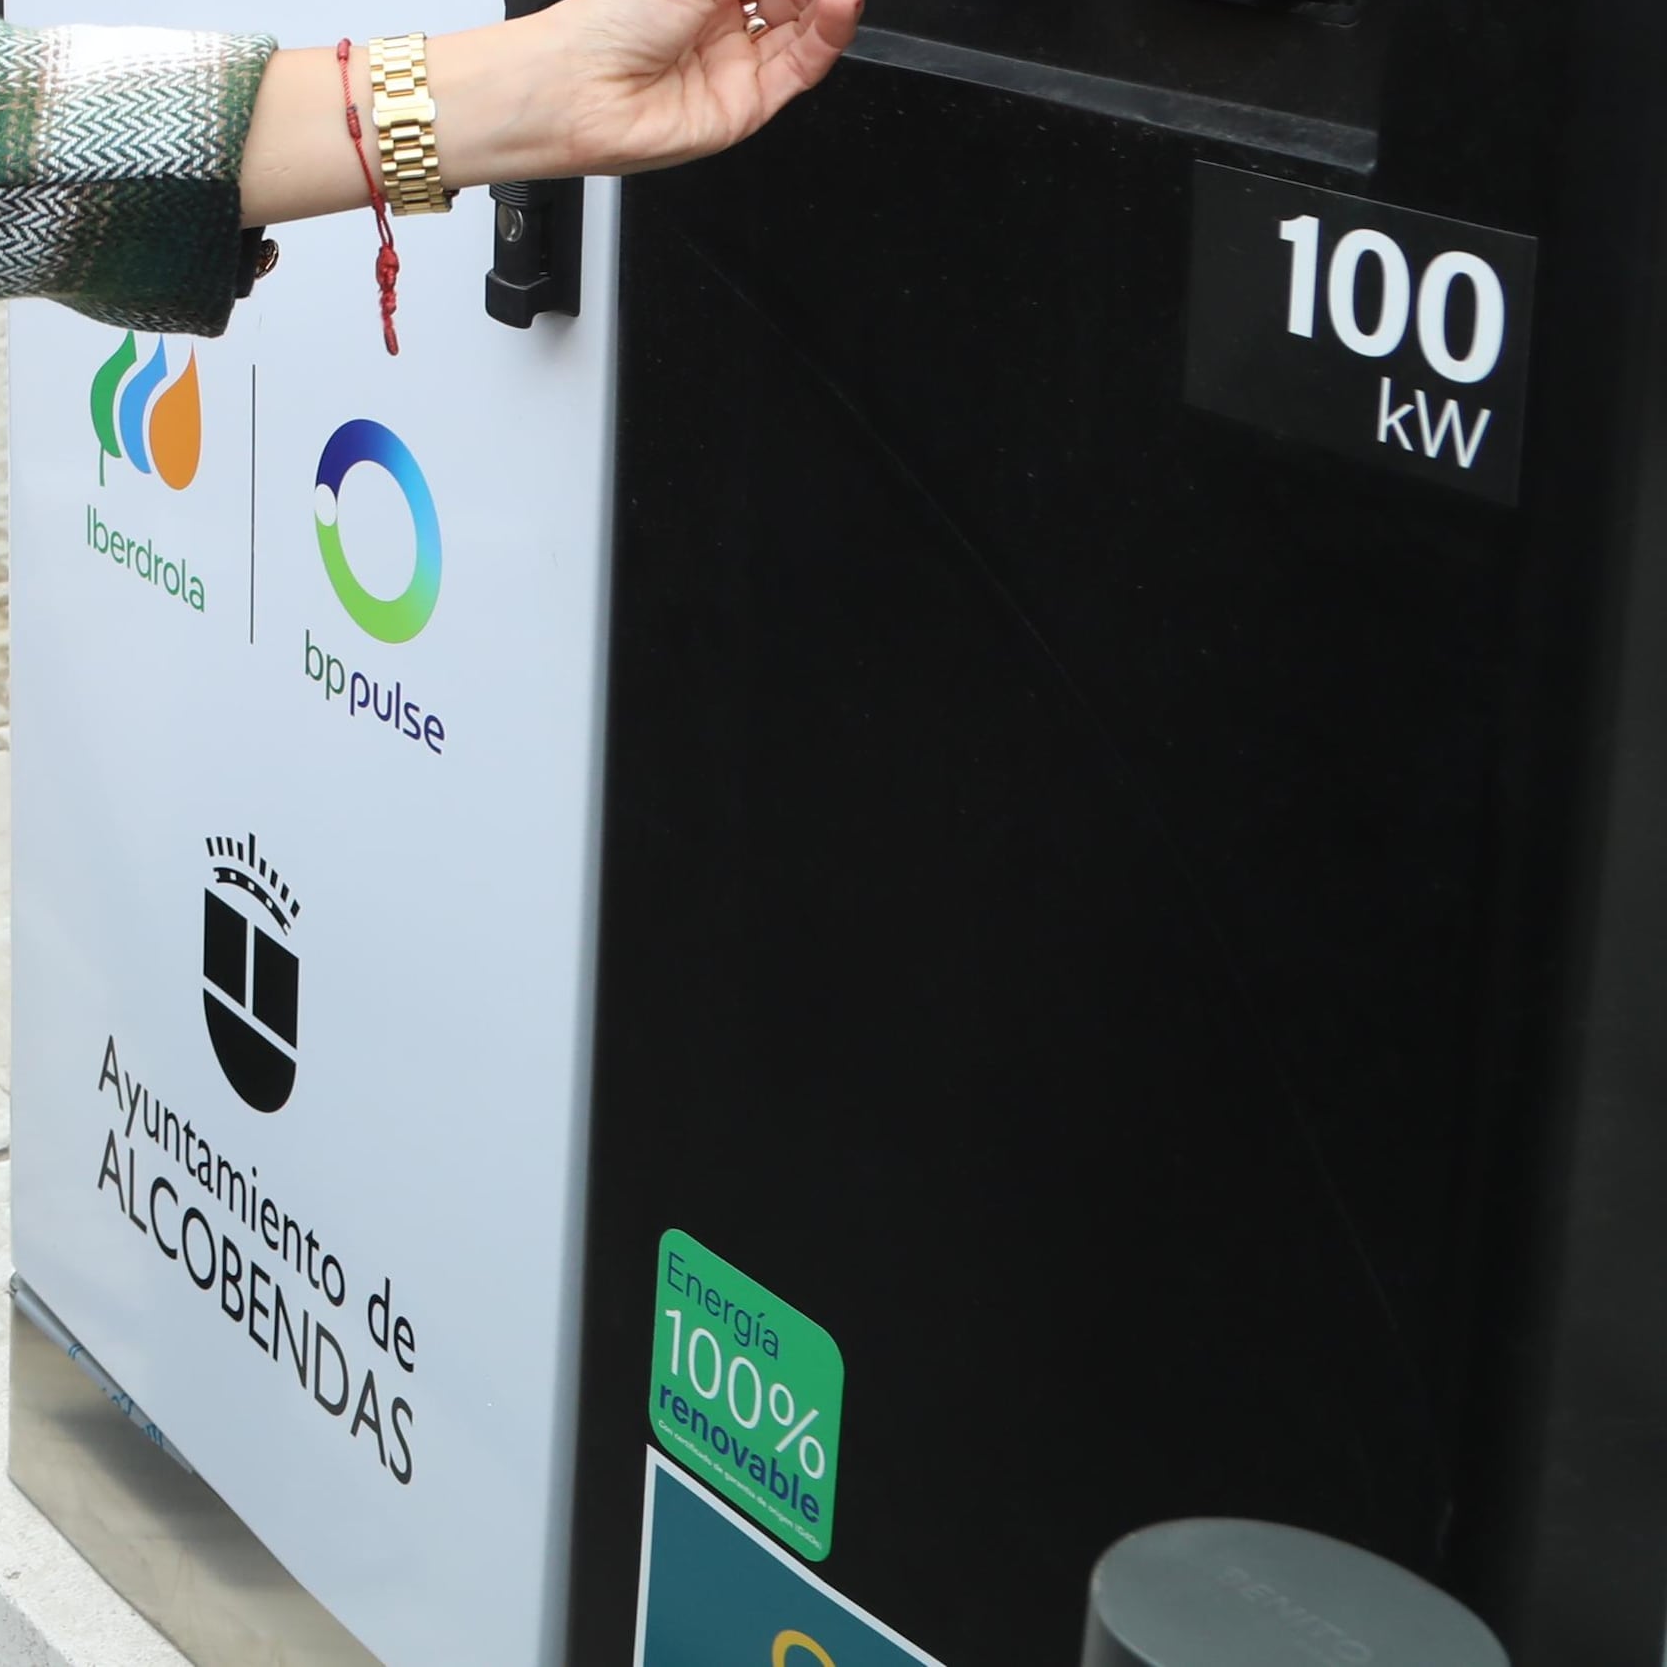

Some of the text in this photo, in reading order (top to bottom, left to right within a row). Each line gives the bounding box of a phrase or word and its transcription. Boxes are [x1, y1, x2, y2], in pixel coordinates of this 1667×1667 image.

[1279, 214, 1505, 384] 100
[1376, 376, 1492, 469] kW
[87, 503, 205, 613] Iberdrola
[98, 1034, 415, 1374] Ayuntamiento de
[97, 1128, 414, 1485] ALCOBENDAS
[667, 1250, 779, 1360] Energía
[659, 1384, 820, 1524] renovable
[665, 1309, 826, 1480] 100%
